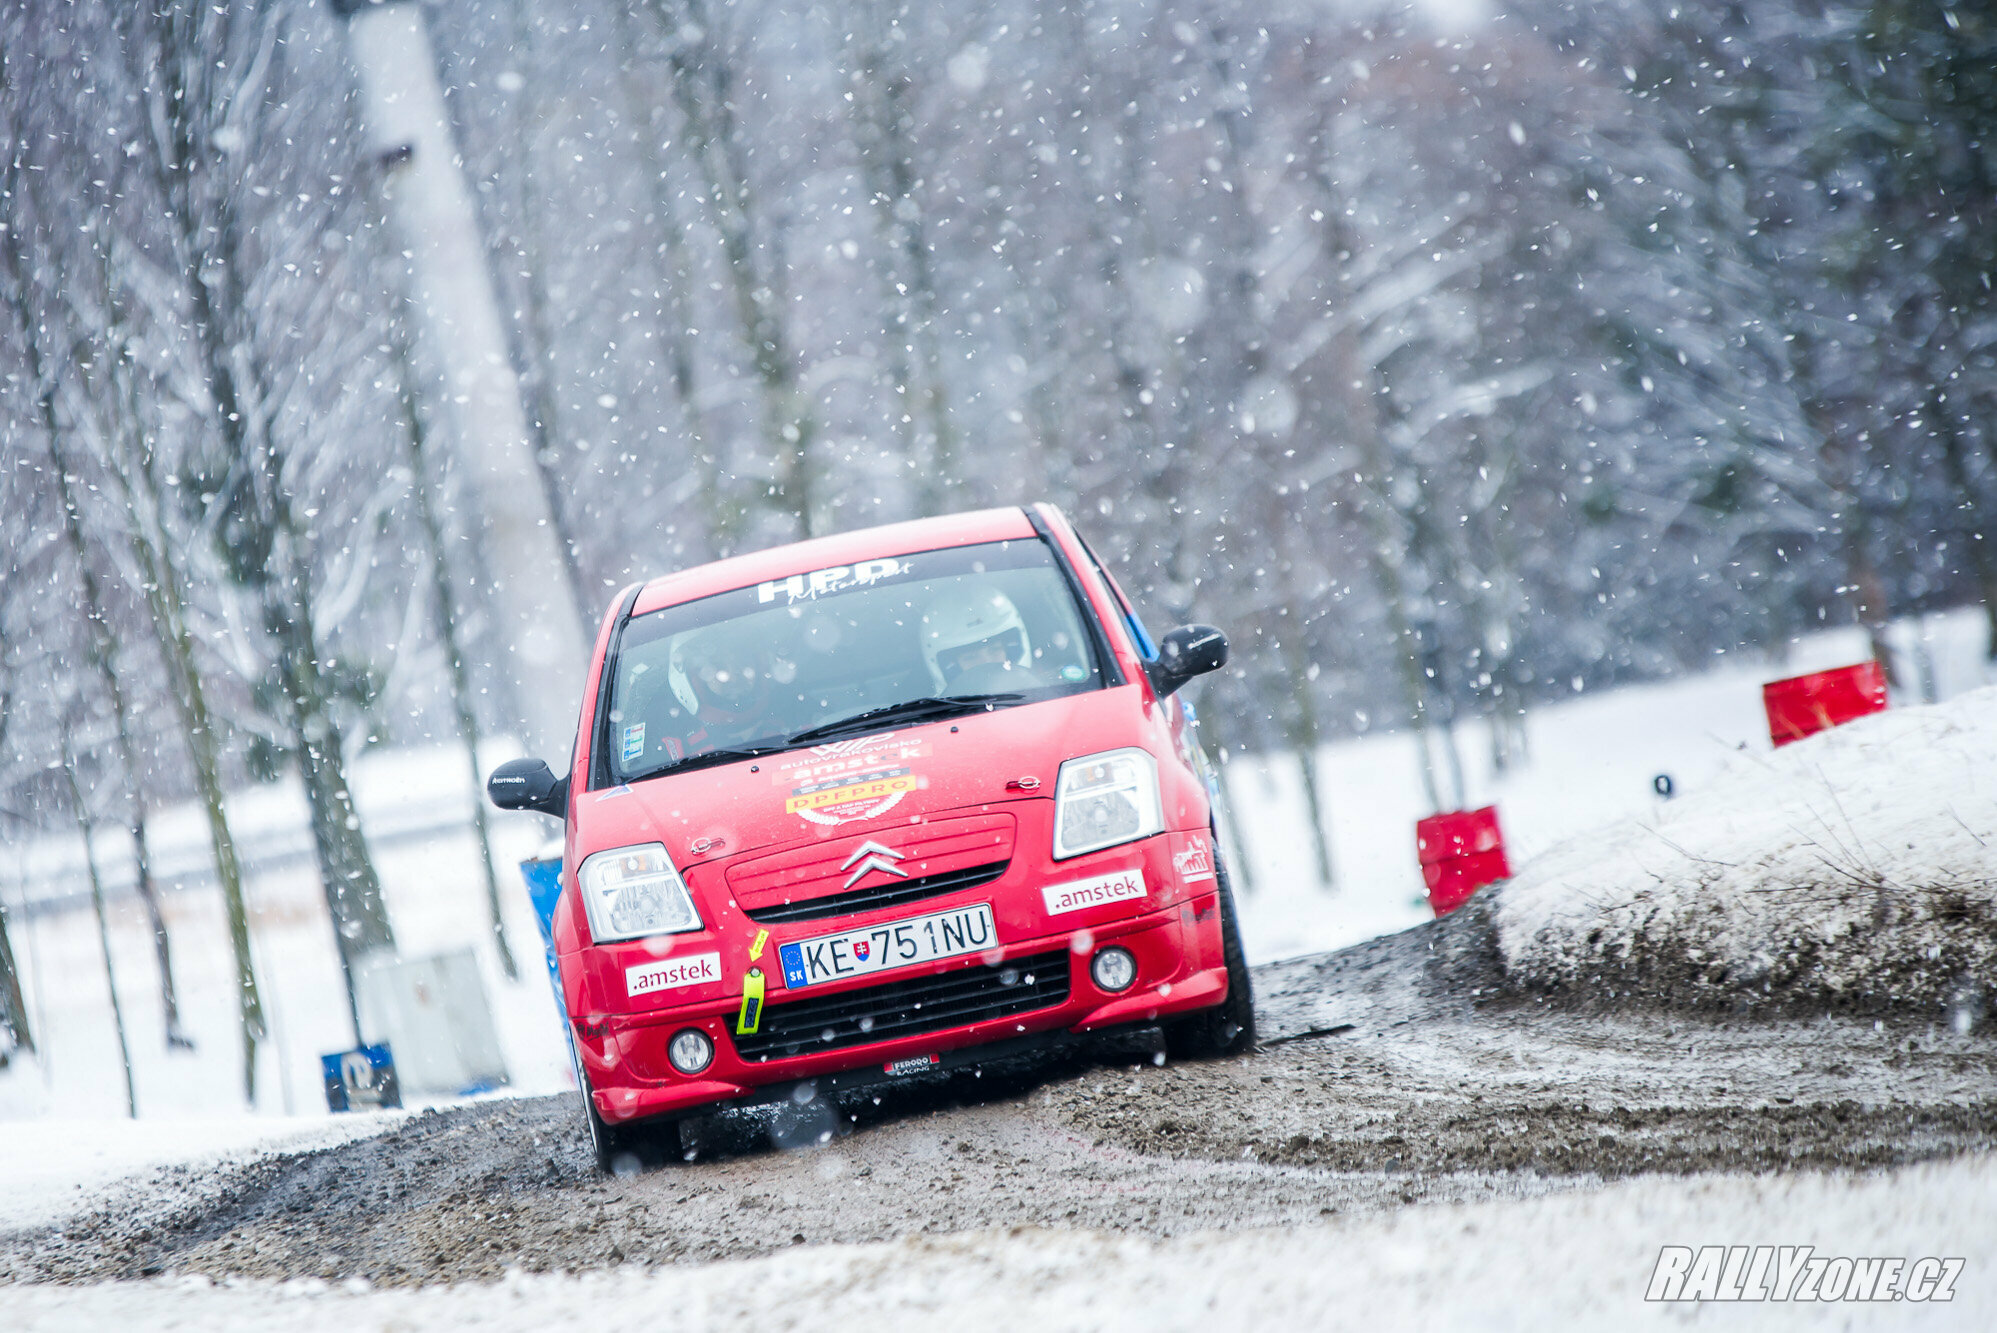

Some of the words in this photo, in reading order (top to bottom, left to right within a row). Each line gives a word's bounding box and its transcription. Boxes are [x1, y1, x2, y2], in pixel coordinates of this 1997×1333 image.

[758, 558, 900, 604] HPD
[794, 781, 907, 809] DPFPRO
[1055, 876, 1139, 909] .amstek
[806, 938, 855, 979] KE
[871, 910, 988, 966] 751NU
[633, 959, 713, 990] .amstek
[789, 970, 804, 982] SK
[894, 1057, 929, 1070] FERODO
